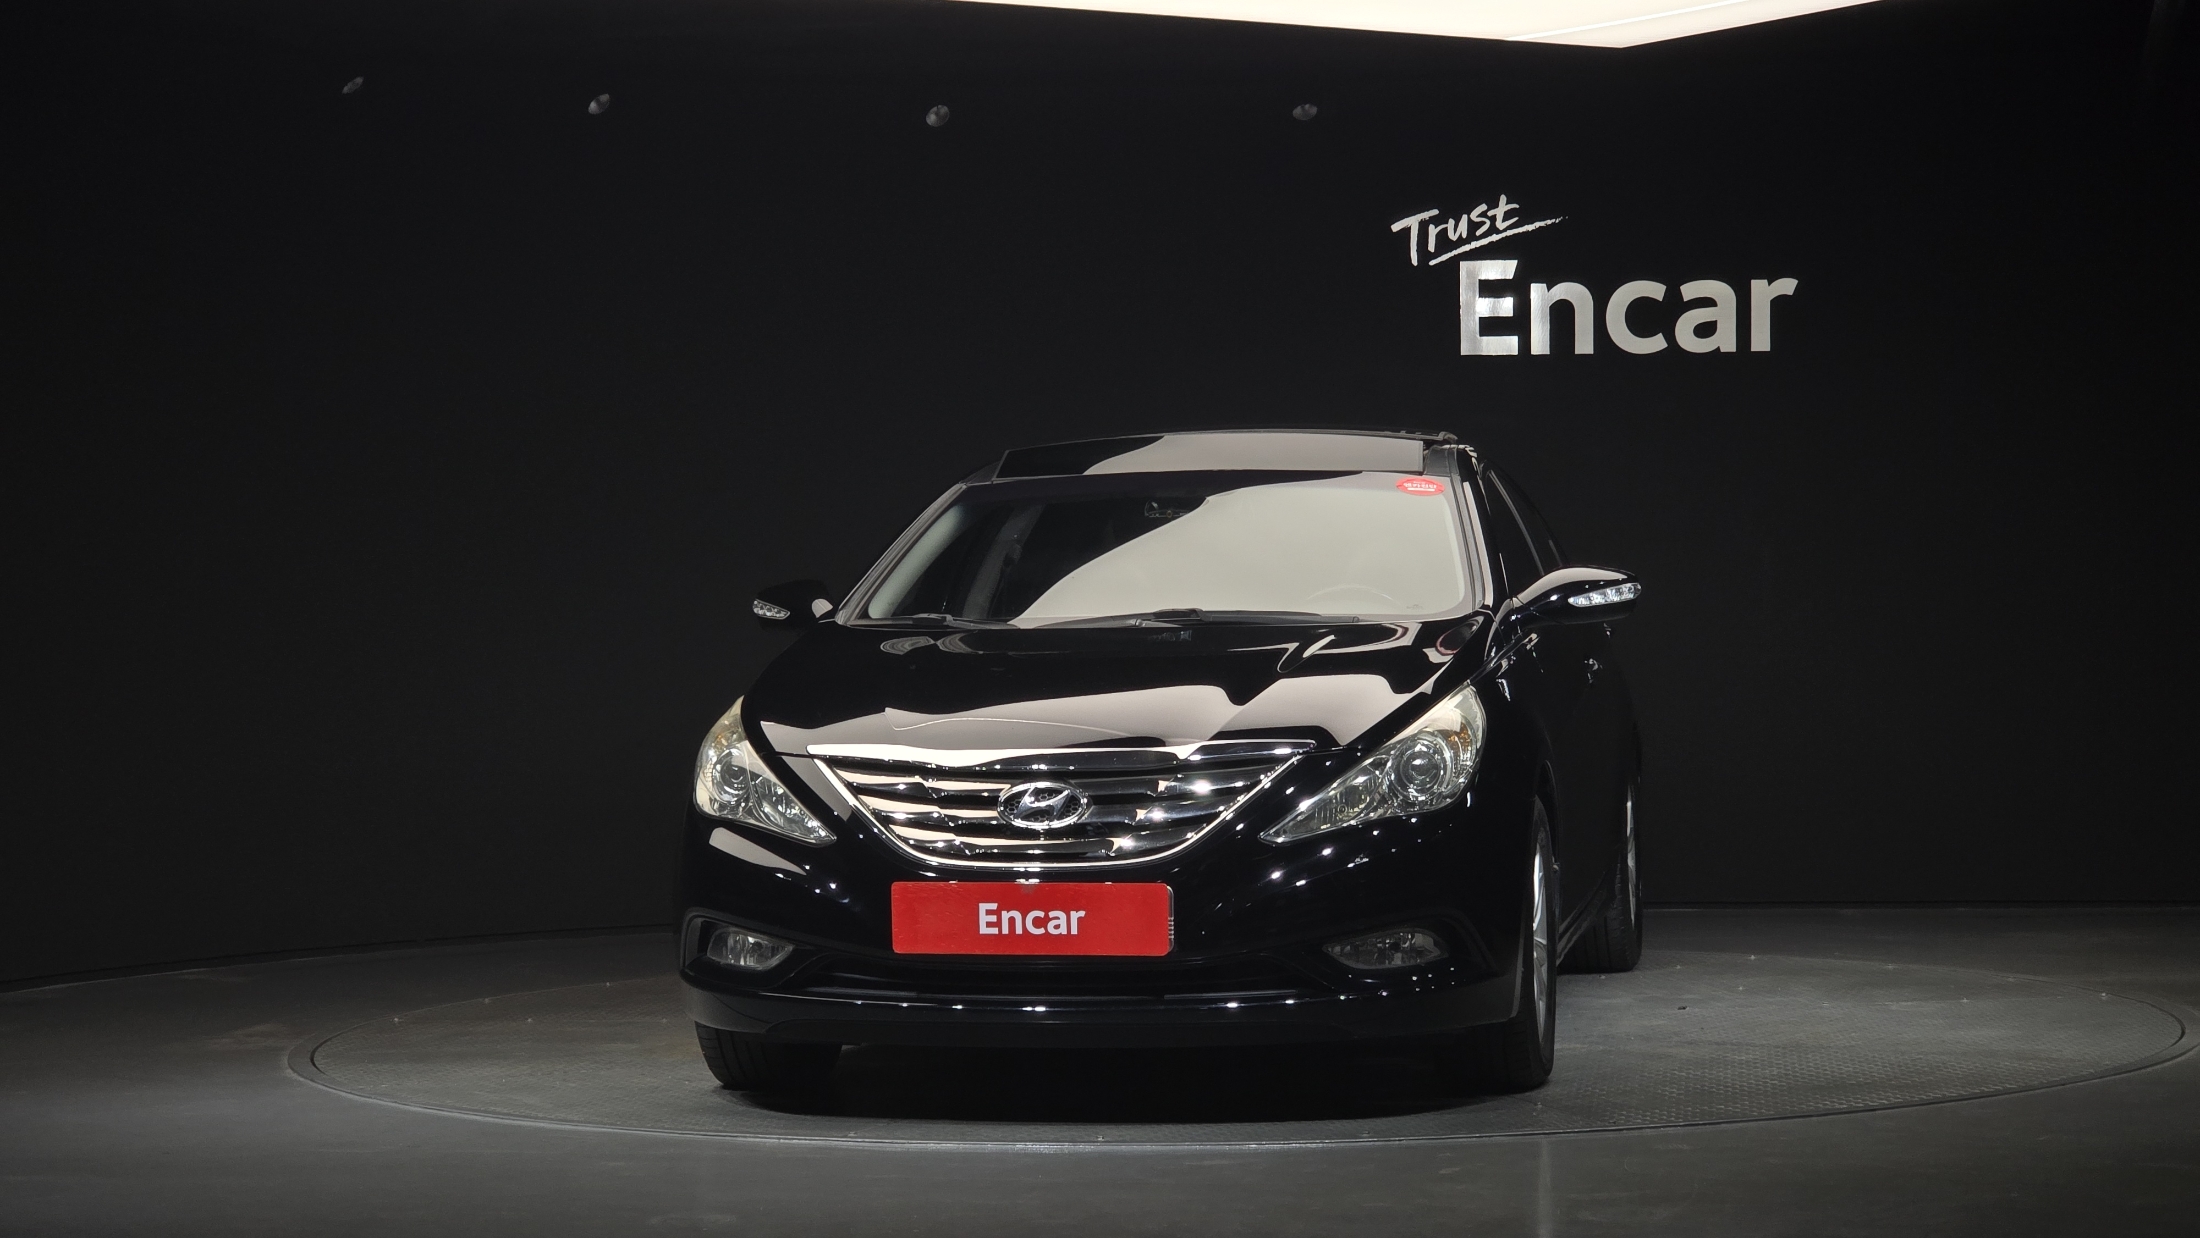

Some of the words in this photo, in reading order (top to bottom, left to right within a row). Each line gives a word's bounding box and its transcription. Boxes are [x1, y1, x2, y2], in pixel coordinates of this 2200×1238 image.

[1390, 193, 1520, 267] Trust
[1459, 259, 1799, 356] Encar
[978, 902, 1086, 935] Encar
